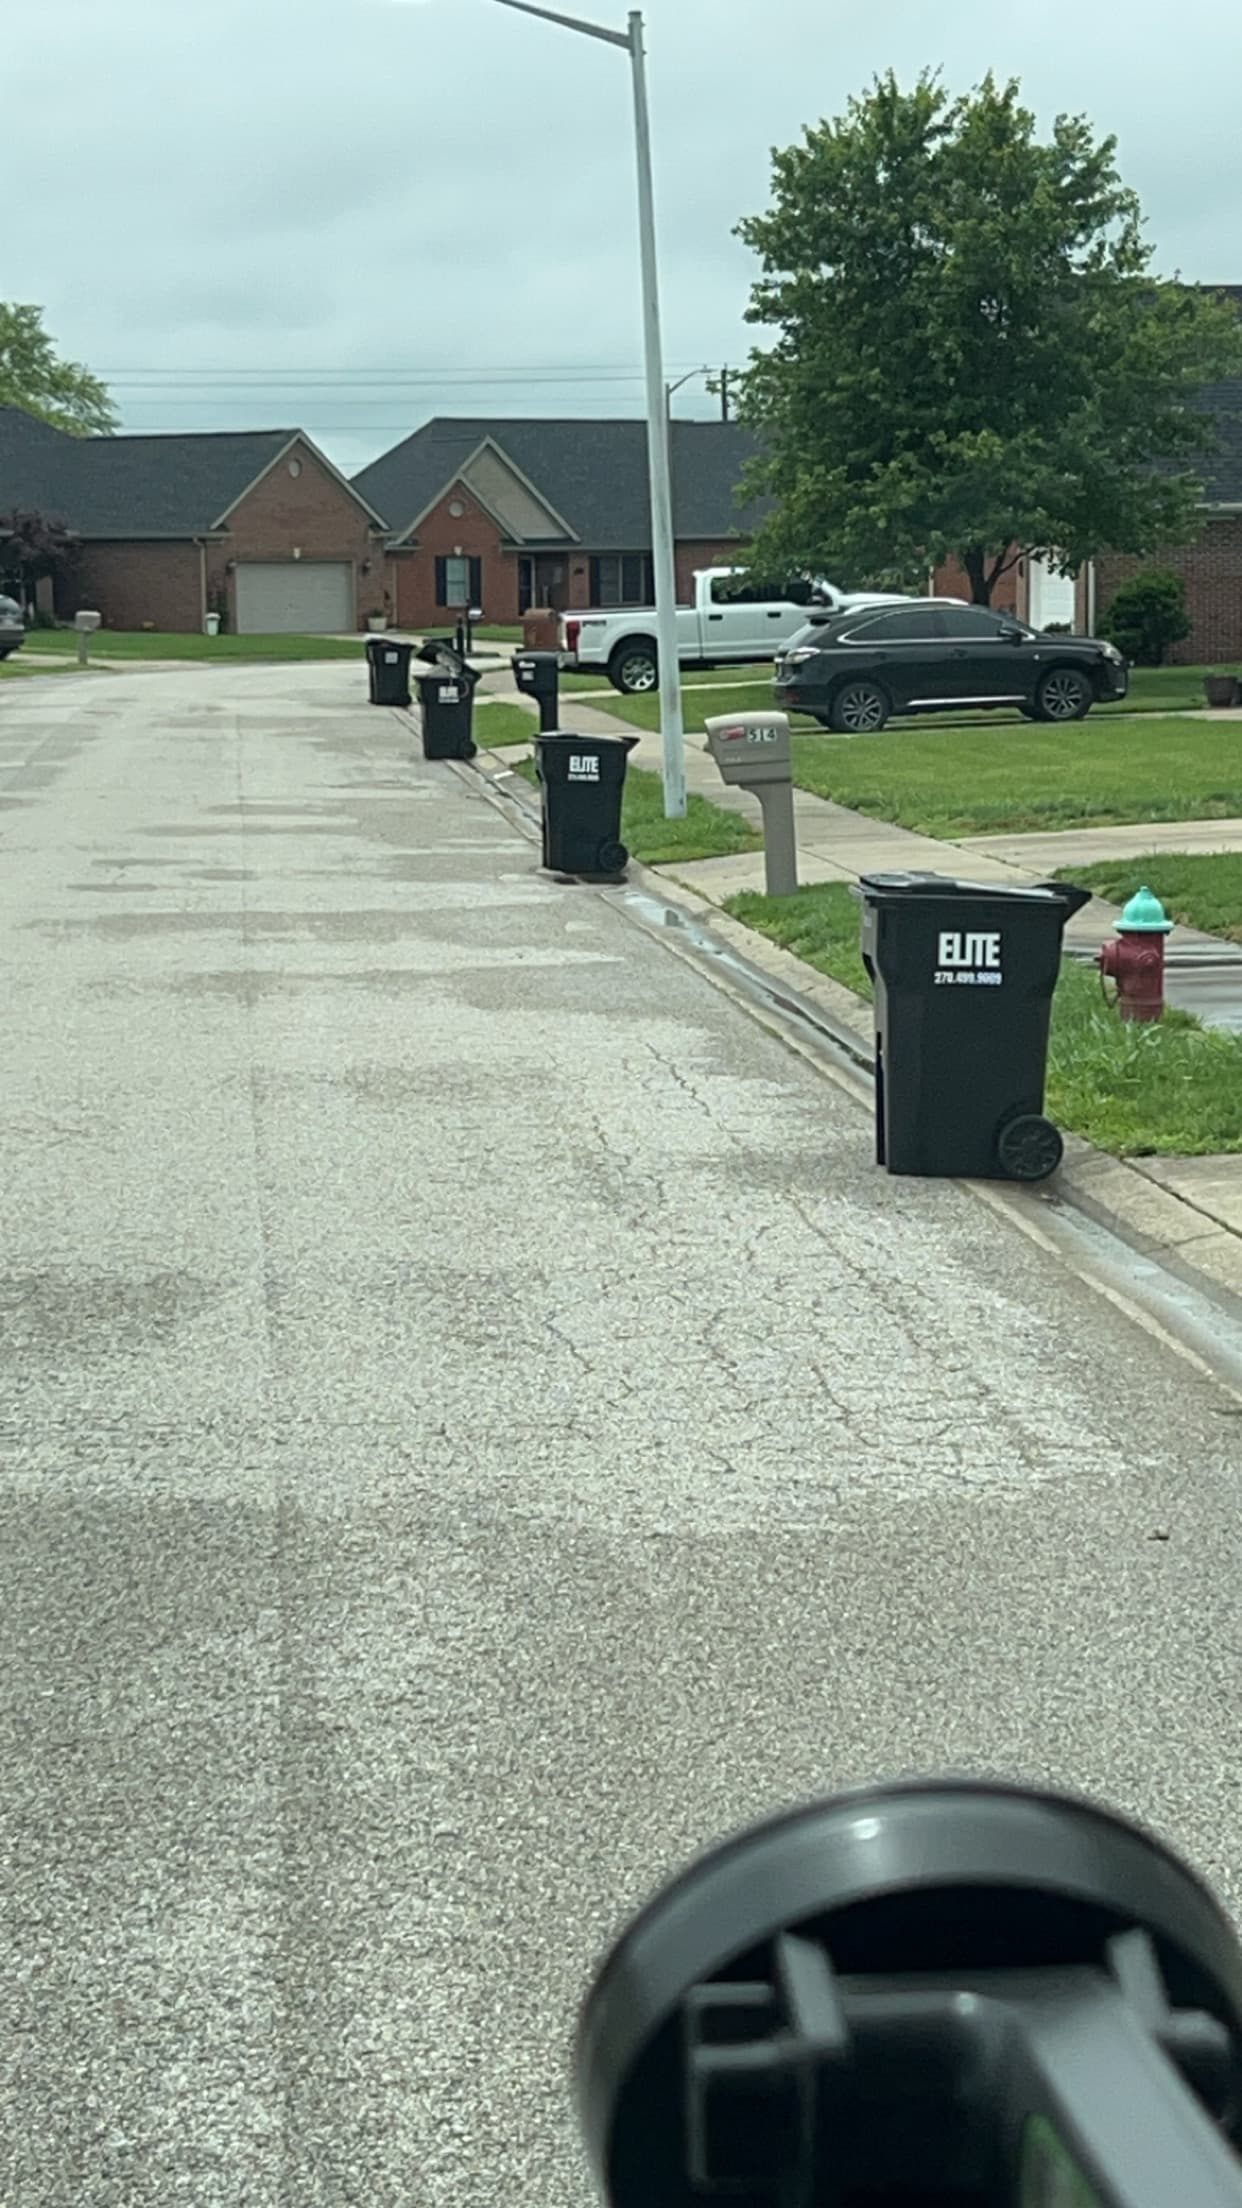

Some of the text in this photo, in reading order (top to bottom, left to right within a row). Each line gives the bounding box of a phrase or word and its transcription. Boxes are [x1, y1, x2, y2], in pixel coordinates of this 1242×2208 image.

[749, 728, 775, 742] 514
[569, 755, 599, 773] ELITE
[938, 932, 1001, 967] ELITE
